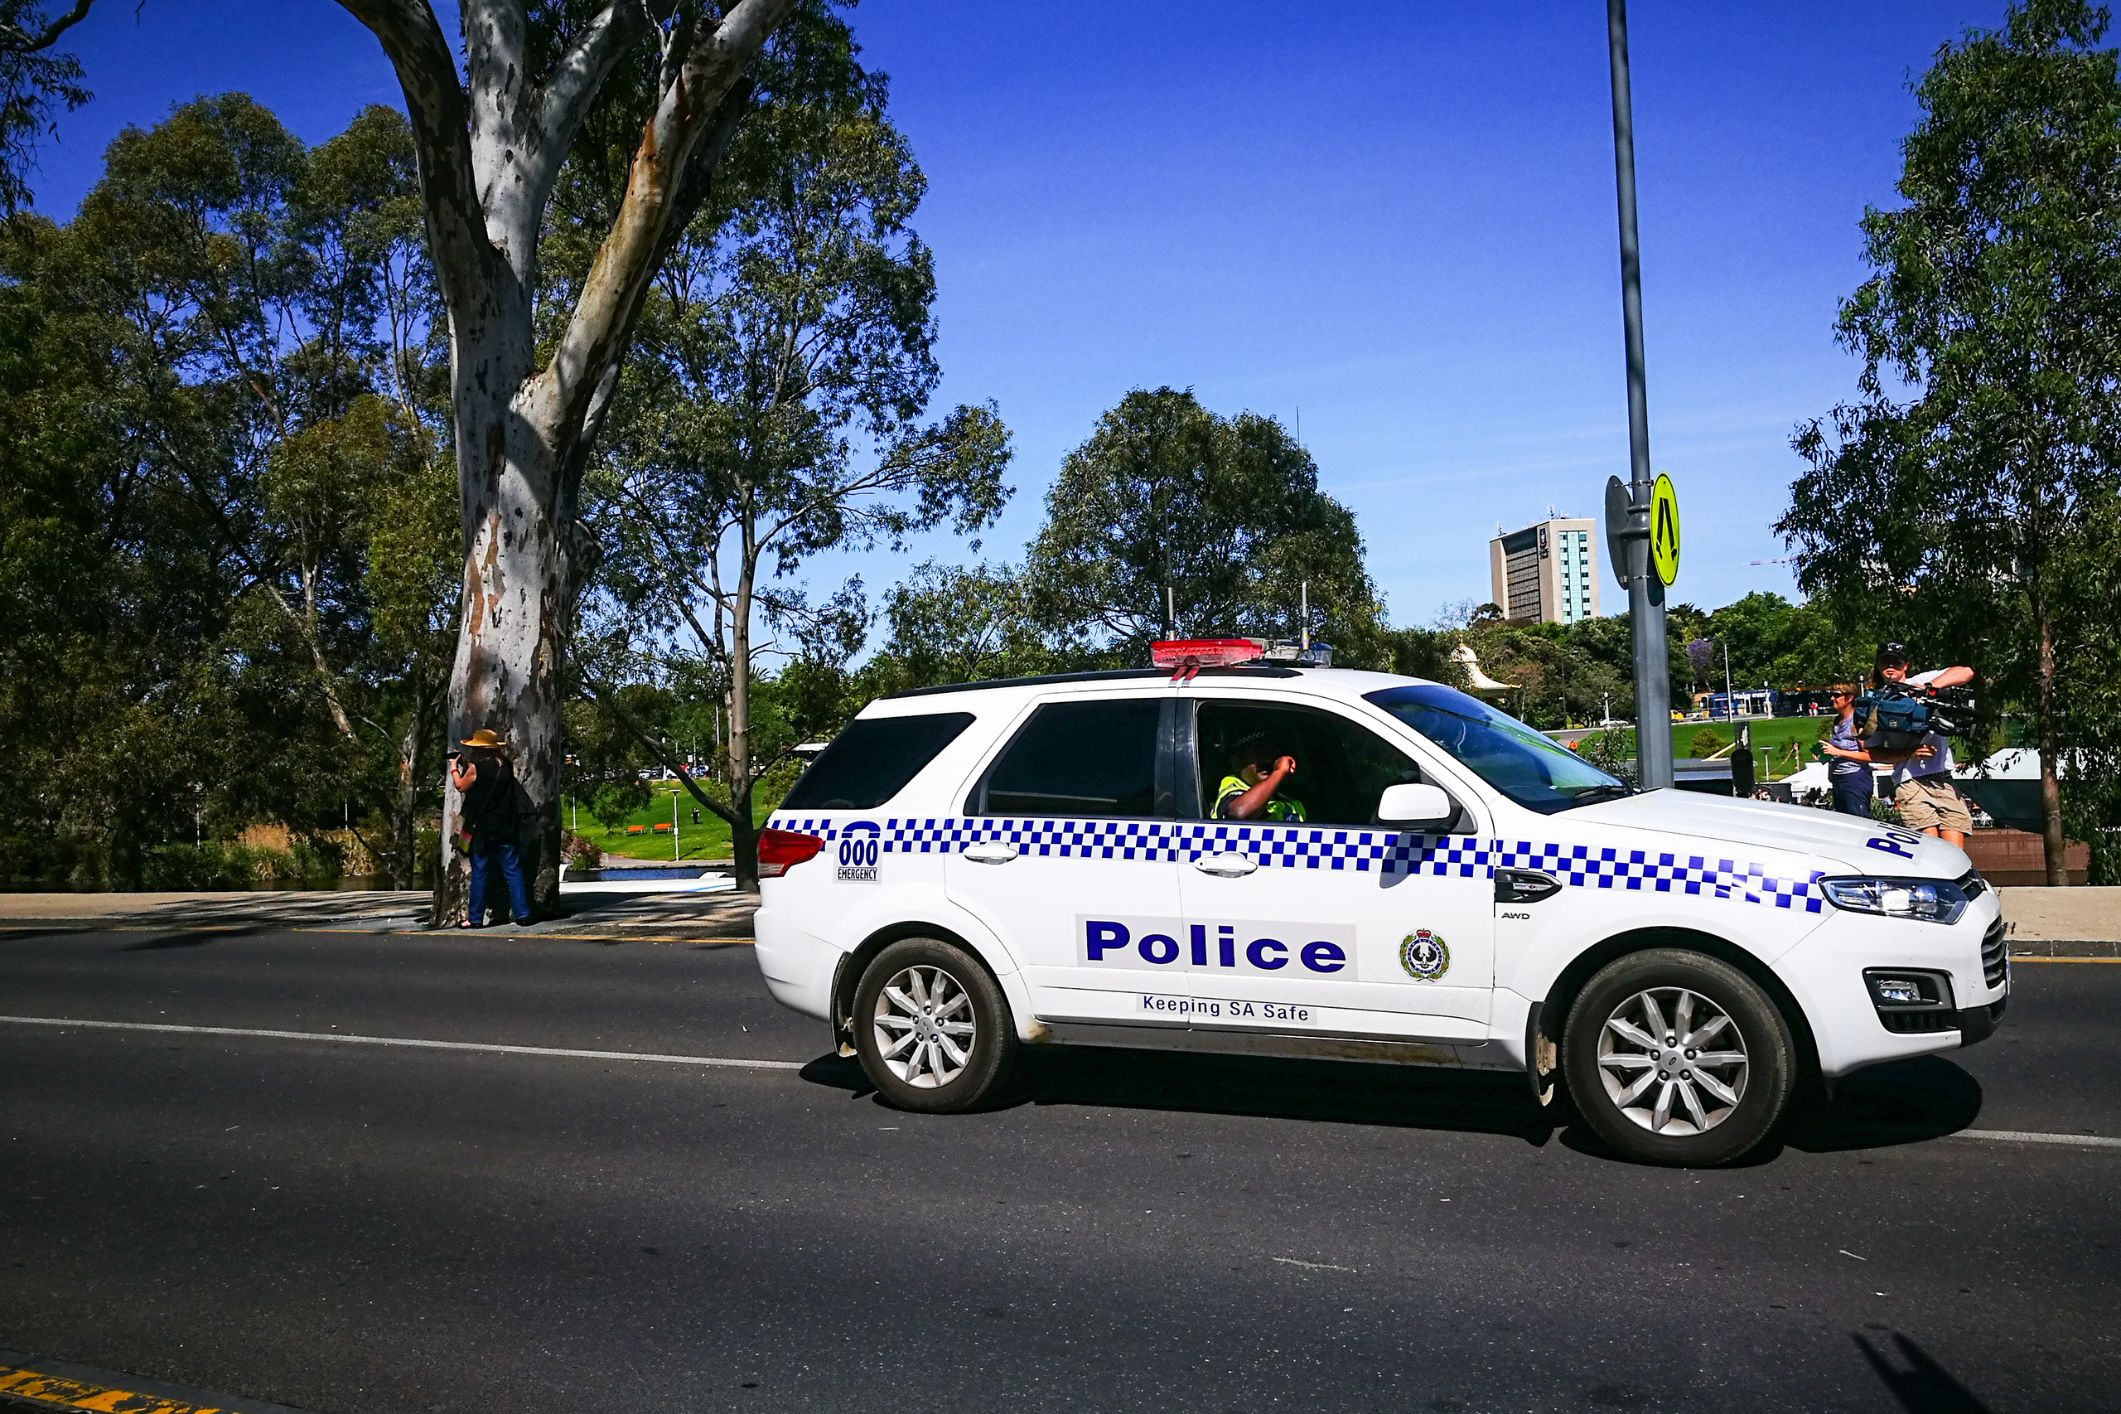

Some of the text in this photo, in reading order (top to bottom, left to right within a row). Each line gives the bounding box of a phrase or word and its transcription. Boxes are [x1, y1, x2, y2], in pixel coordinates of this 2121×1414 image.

[838, 838, 879, 867] 000
[1866, 822, 1923, 860] Poli
[837, 868, 878, 880] EMERGENCY
[1501, 912, 1531, 920] AWD
[1085, 920, 1347, 974] Police
[1143, 995, 1309, 1021] Keeping SA Safe
